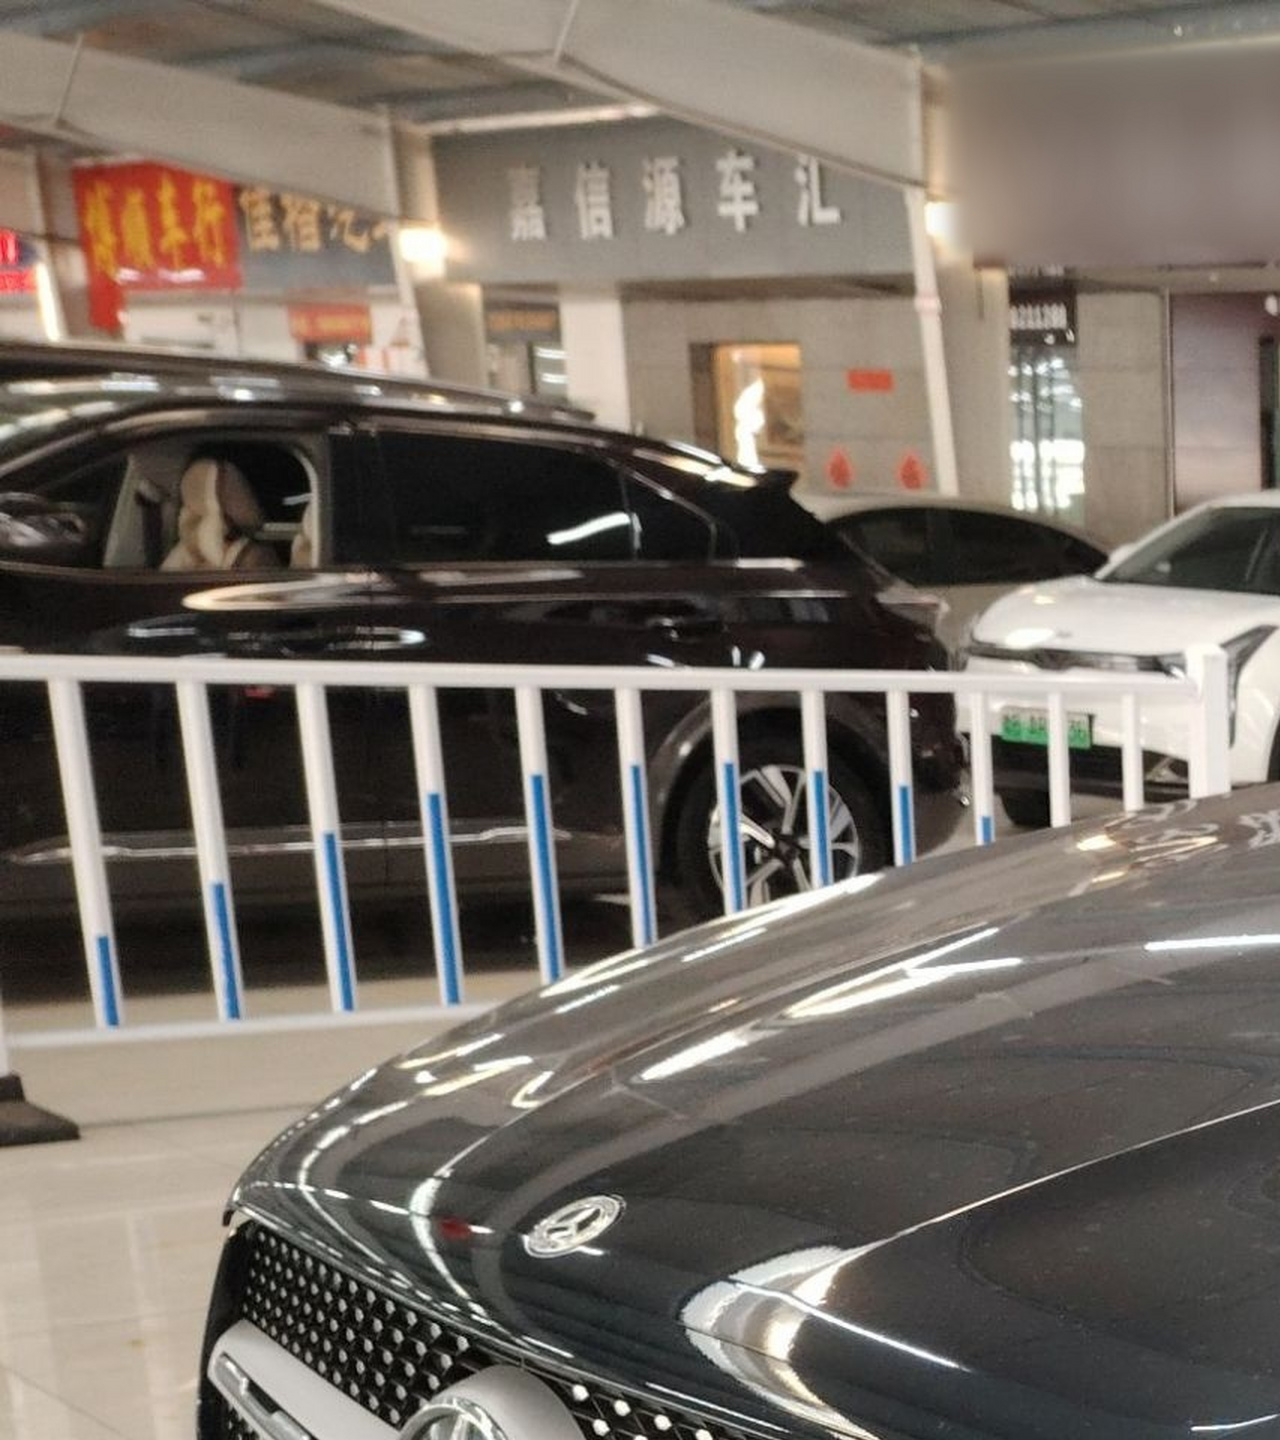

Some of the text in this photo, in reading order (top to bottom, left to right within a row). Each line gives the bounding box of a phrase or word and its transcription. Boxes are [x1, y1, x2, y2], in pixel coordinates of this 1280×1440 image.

[506, 150, 842, 240] 嘉信源车汇
